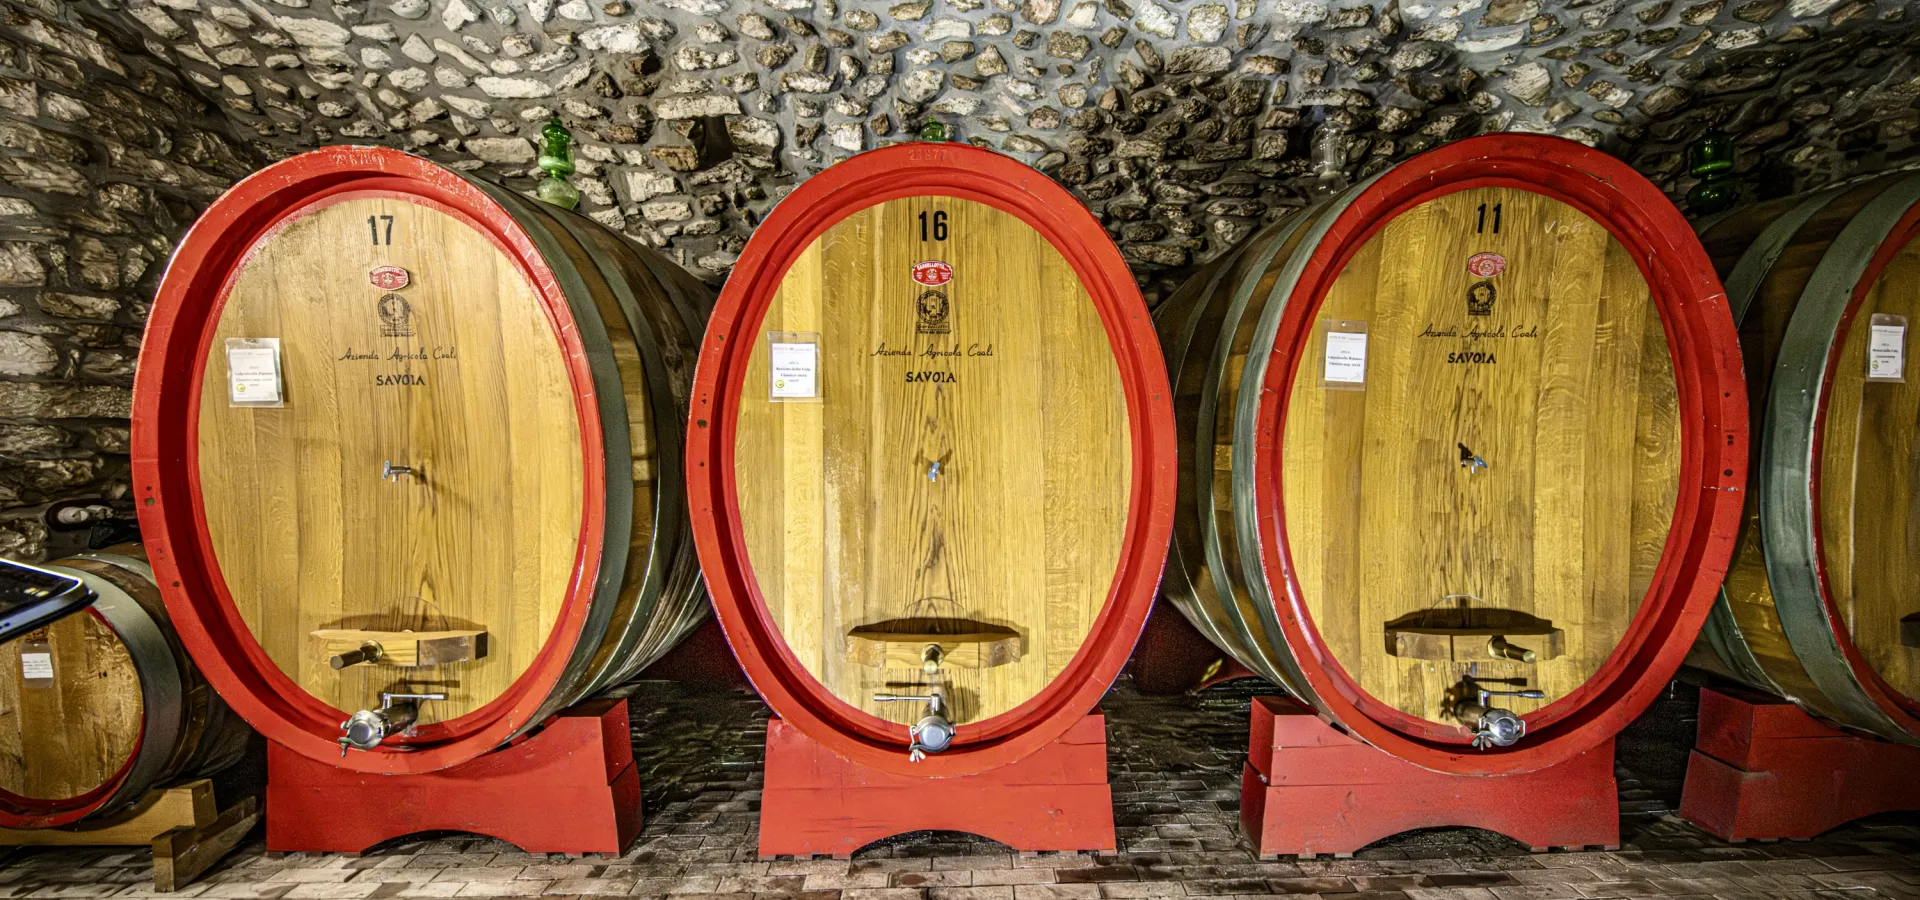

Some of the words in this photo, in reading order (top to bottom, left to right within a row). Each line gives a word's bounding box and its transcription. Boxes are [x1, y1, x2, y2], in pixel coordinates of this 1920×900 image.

[918, 210, 948, 242] 16
[1477, 203, 1502, 234] 11
[367, 214, 394, 246] 17
[1461, 324, 1505, 341] Agricola
[387, 346, 428, 363] Agricola
[870, 342, 912, 357] Azienda
[918, 343, 962, 360] Agricola
[1447, 351, 1497, 365] SAVOIA
[376, 374, 426, 387] SAVOIA
[905, 371, 957, 383] SAVOIA
